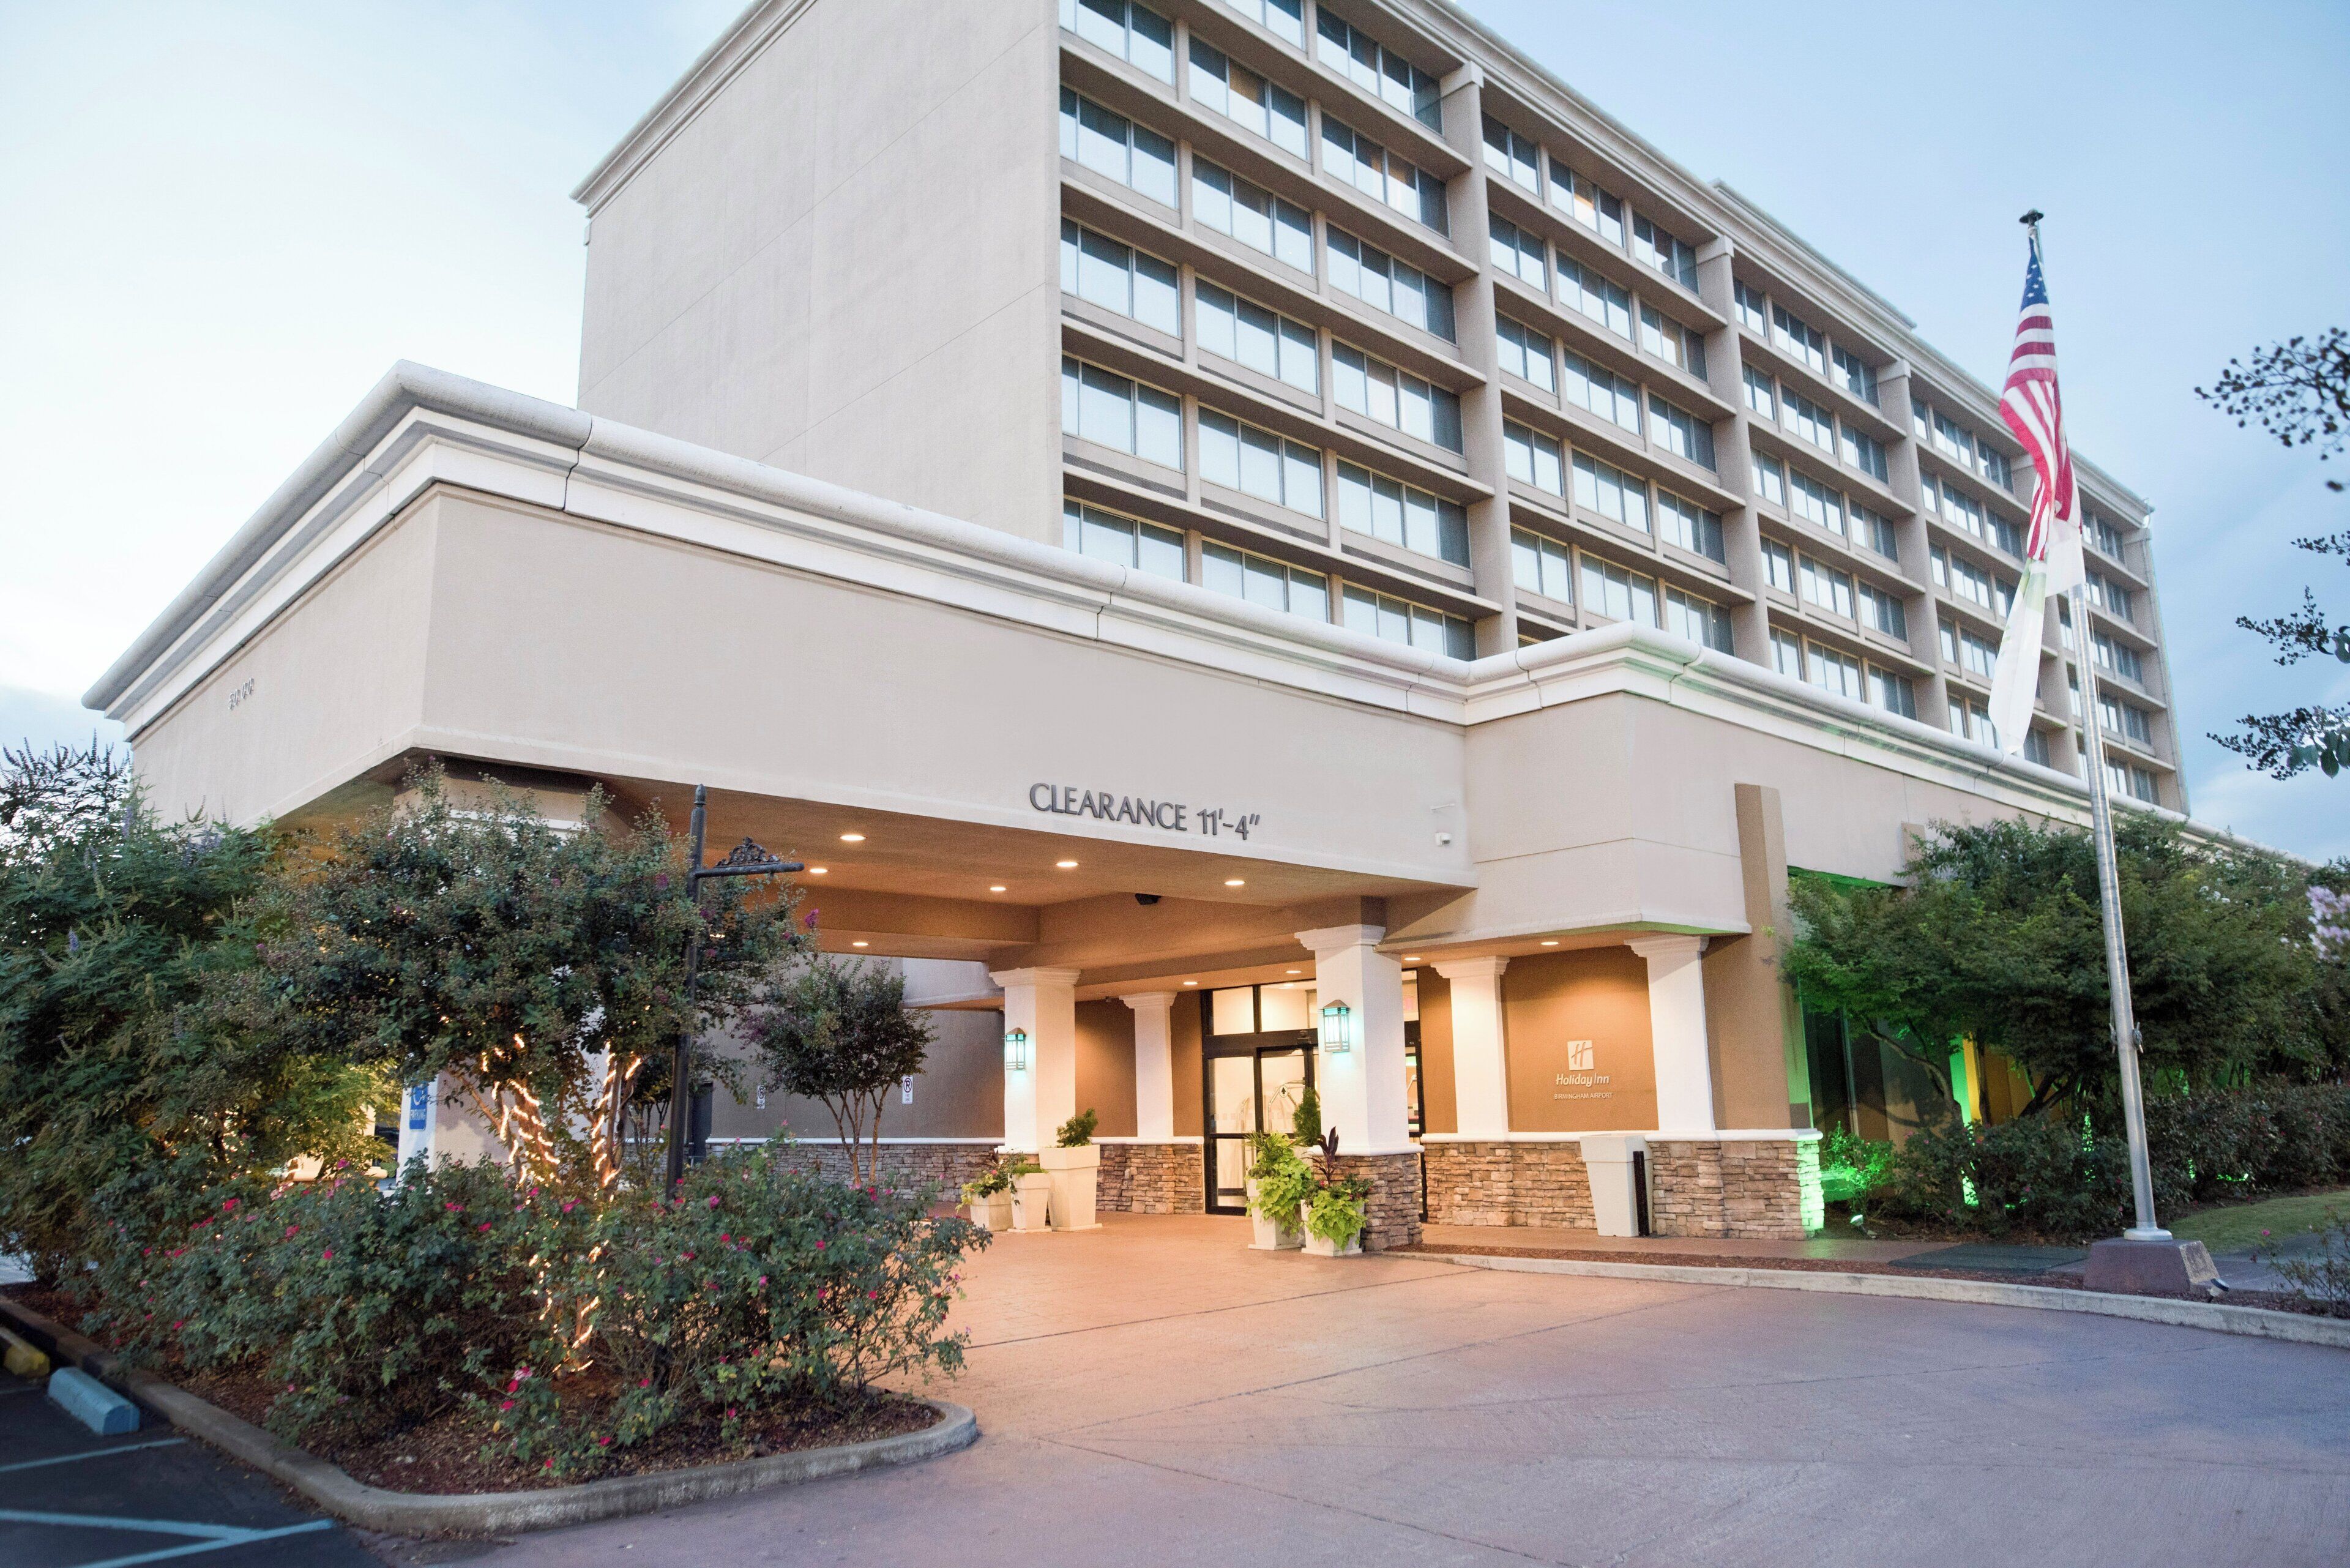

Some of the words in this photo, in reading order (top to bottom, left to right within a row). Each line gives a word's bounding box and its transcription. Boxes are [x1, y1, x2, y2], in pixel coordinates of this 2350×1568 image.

[1029, 782, 1187, 831] CLEARANCE
[1556, 1073, 1592, 1087] Holiday
[1594, 1073, 1610, 1085] Inn
